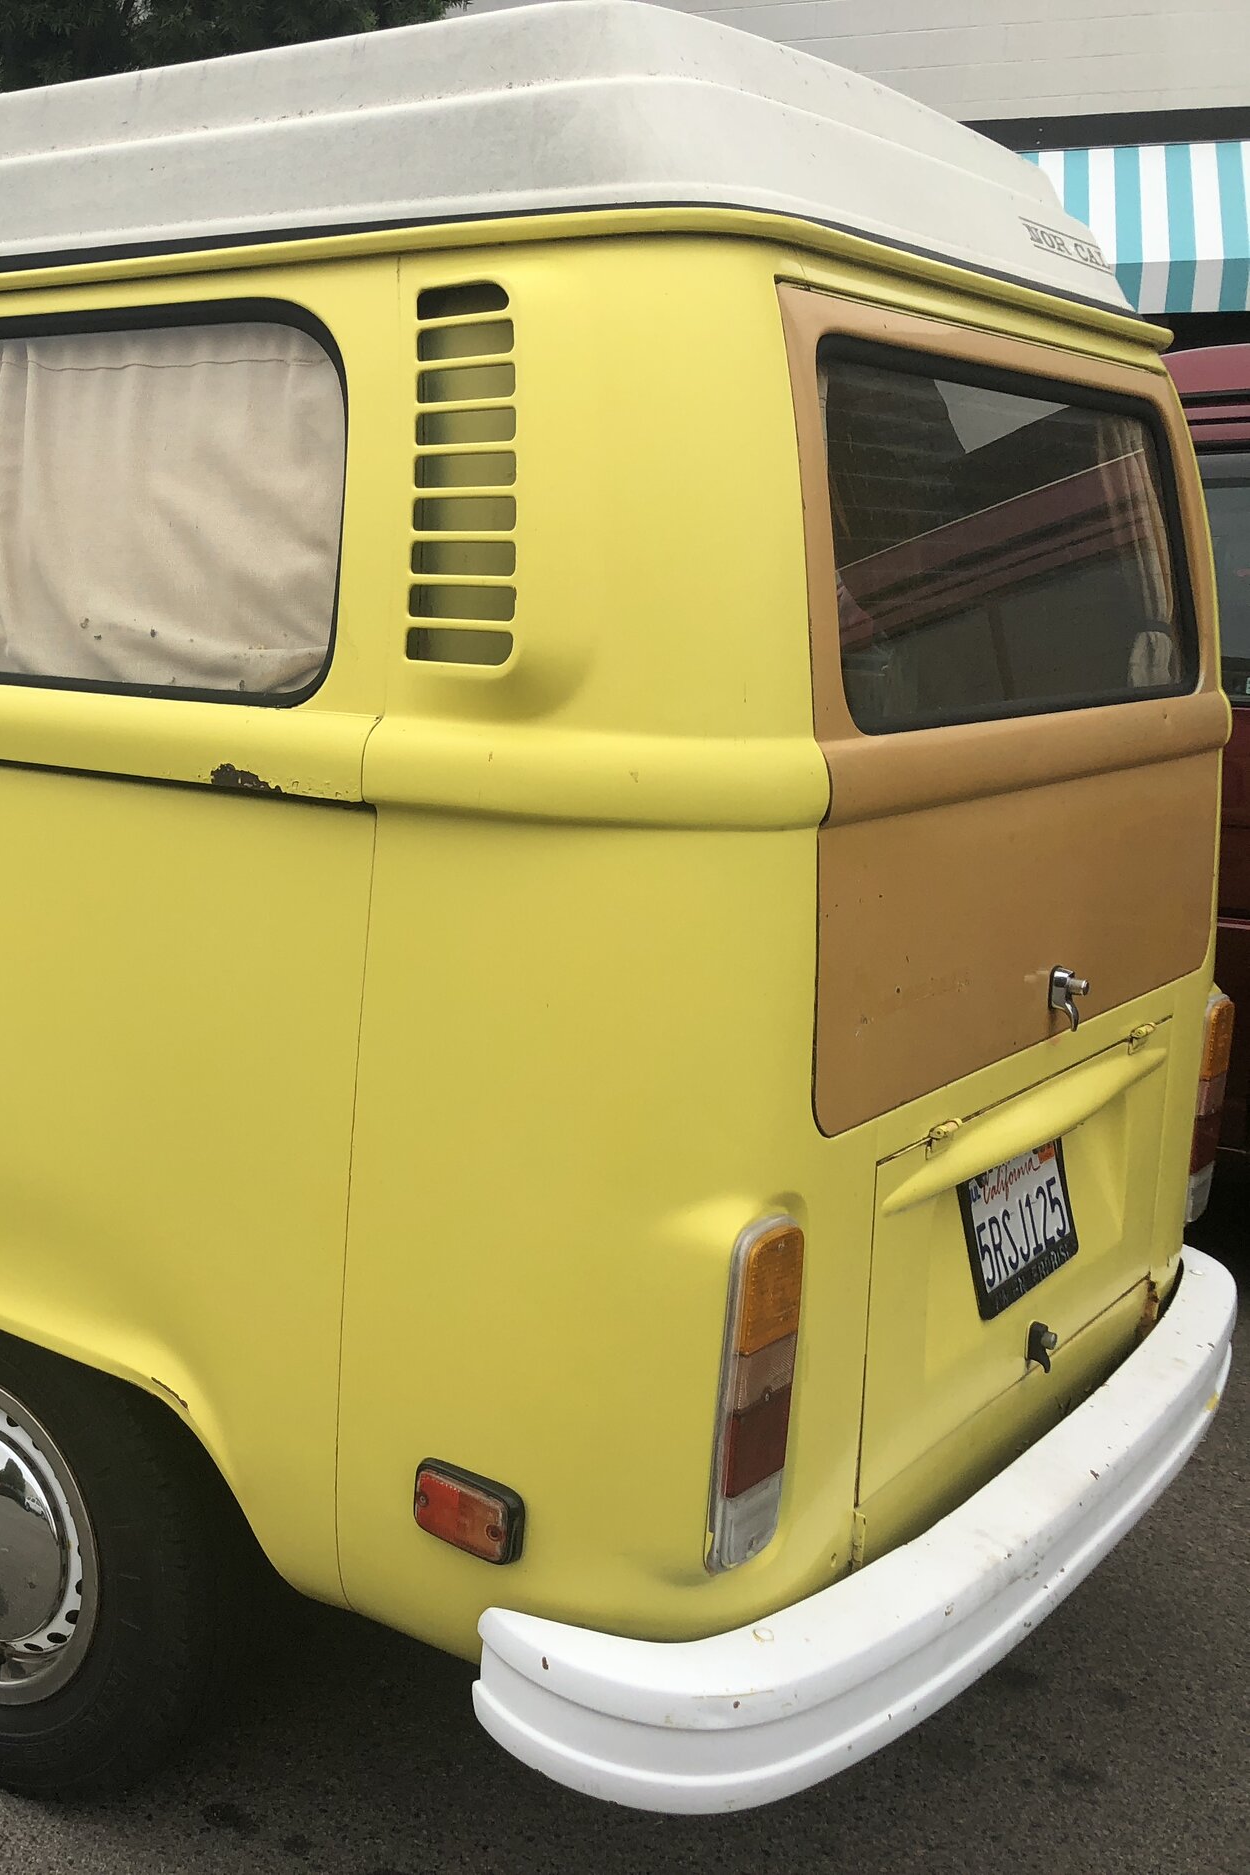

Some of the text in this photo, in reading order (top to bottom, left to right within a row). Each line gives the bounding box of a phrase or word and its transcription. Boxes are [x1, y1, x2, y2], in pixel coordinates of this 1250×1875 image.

[1022, 223, 1111, 270] NOR CAL
[981, 1158, 1041, 1204] California
[975, 1176, 1067, 1288] 5RSJ125
